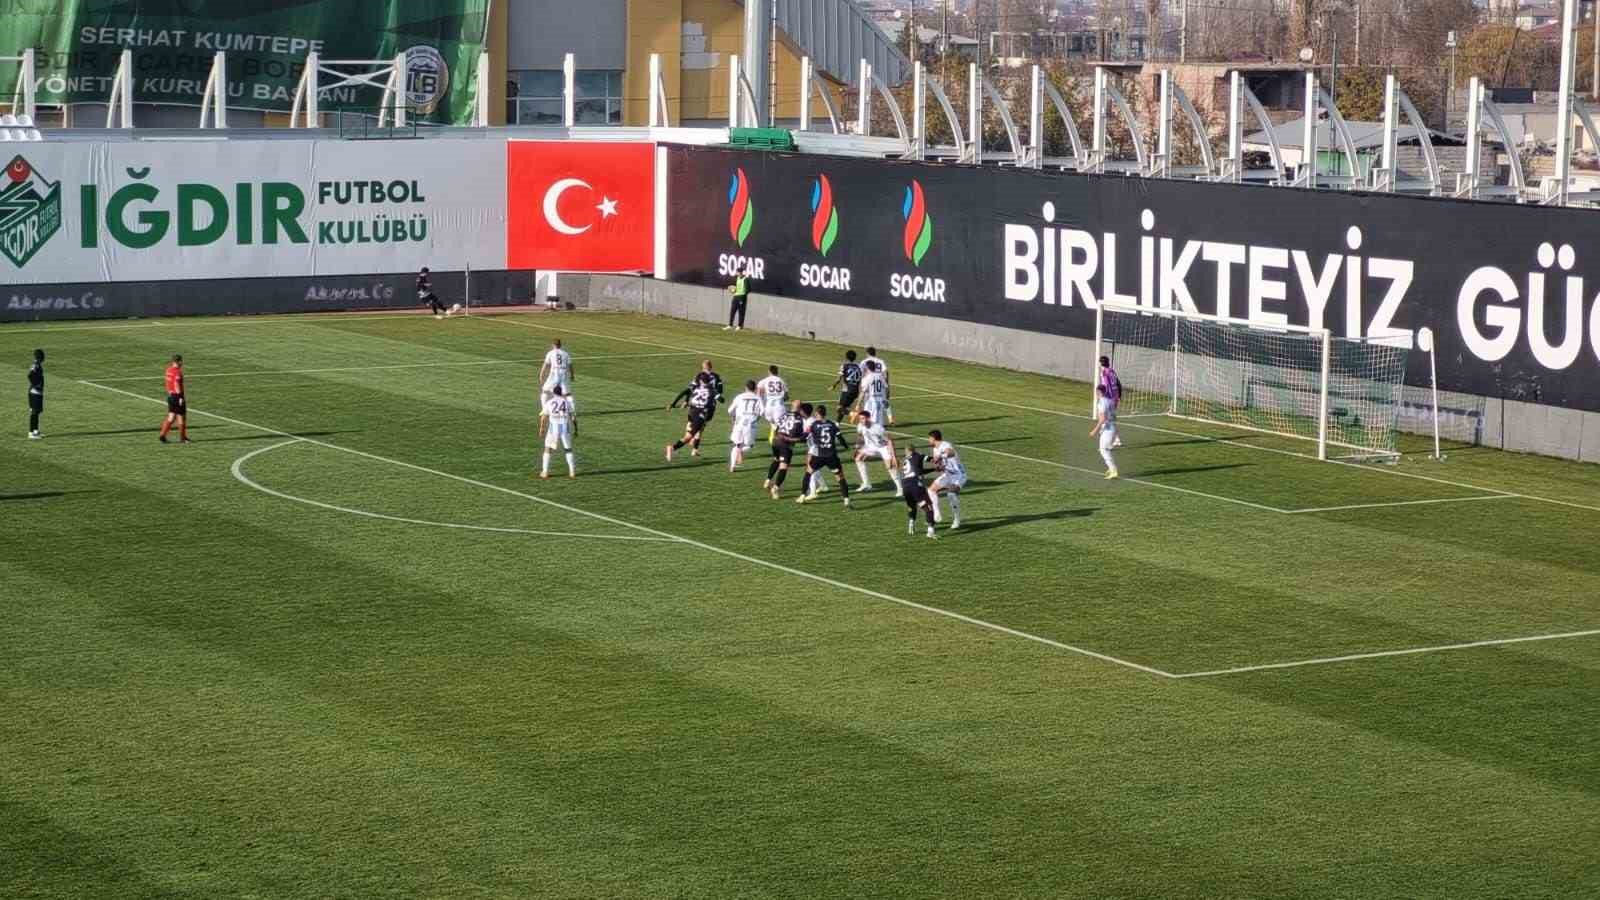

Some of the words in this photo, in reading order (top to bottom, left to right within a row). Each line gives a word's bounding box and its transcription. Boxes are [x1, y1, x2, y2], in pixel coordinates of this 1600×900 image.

[80, 26, 187, 46] SERHAT
[194, 31, 325, 56] KUMTEPE
[33, 73, 136, 93] YÖNET
[142, 78, 244, 97] KURUU
[253, 84, 357, 103] BAANI
[318, 180, 425, 204] FUTBOL
[80, 166, 309, 249] IĞDIR
[318, 213, 427, 244] KULÜBÜ
[719, 253, 765, 280] SOCAR
[800, 263, 851, 291] SOCAR
[1003, 200, 1433, 352] BİRLİKTEYİZ.
[890, 272, 946, 302] SOCAR
[768, 381, 783, 393] 53
[847, 367, 860, 385] 20
[871, 377, 882, 393] 10
[551, 401, 566, 414] 24
[742, 398, 758, 412] 77
[820, 427, 831, 444] 5
